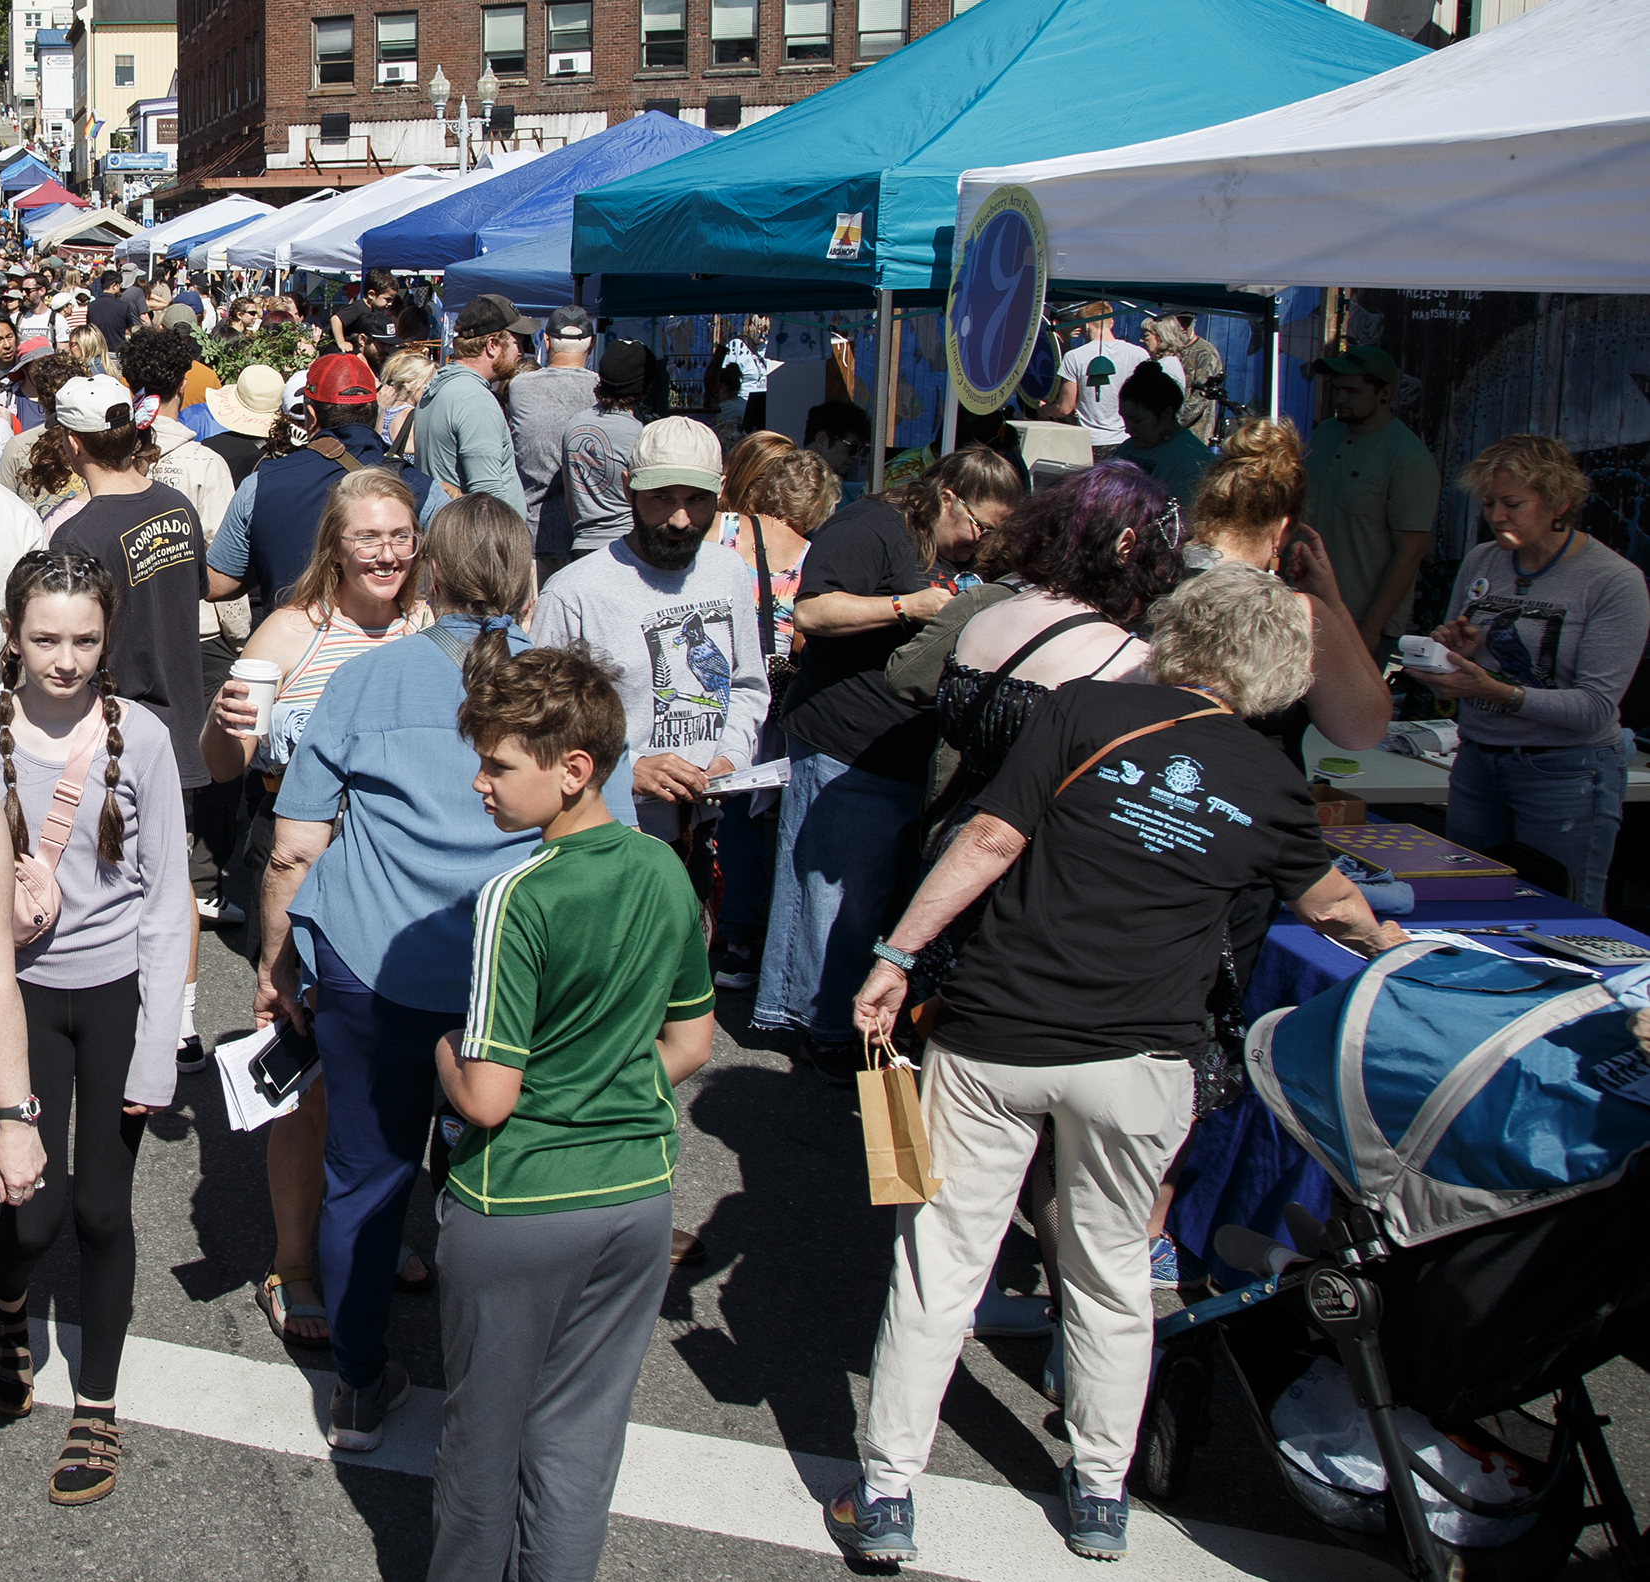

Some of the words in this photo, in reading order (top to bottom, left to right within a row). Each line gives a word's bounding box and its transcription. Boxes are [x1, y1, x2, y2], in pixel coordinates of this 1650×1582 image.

[975, 198, 1008, 233] Blueberry
[1009, 194, 1022, 208] Arts
[1022, 199, 1041, 239] Festival
[1019, 330, 1033, 363] Area
[950, 338, 964, 386] Council
[1006, 364, 1020, 389] Arts
[963, 383, 998, 407] Humanities
[129, 518, 191, 559] CORONADO
[156, 540, 189, 557] COMPANY
[656, 603, 695, 619] KETCHIKAN
[699, 599, 722, 609] ALASKA
[669, 710, 693, 719] ANNUAL
[648, 733, 681, 748] ARTS
[1098, 772, 1121, 784] Health
[1115, 797, 1153, 814] Ketchikan
[1153, 809, 1185, 826] Wellness
[1185, 822, 1215, 838] Coalition
[1124, 808, 1164, 826] Lighthouse
[1163, 822, 1201, 842] Excursions
[1109, 812, 1140, 828] Madison
[1140, 823, 1168, 838] Lumber
[1167, 833, 1175, 841] &
[1175, 836, 1207, 854] Hardware
[1138, 831, 1156, 842] First
[1155, 837, 1175, 850] Bank
